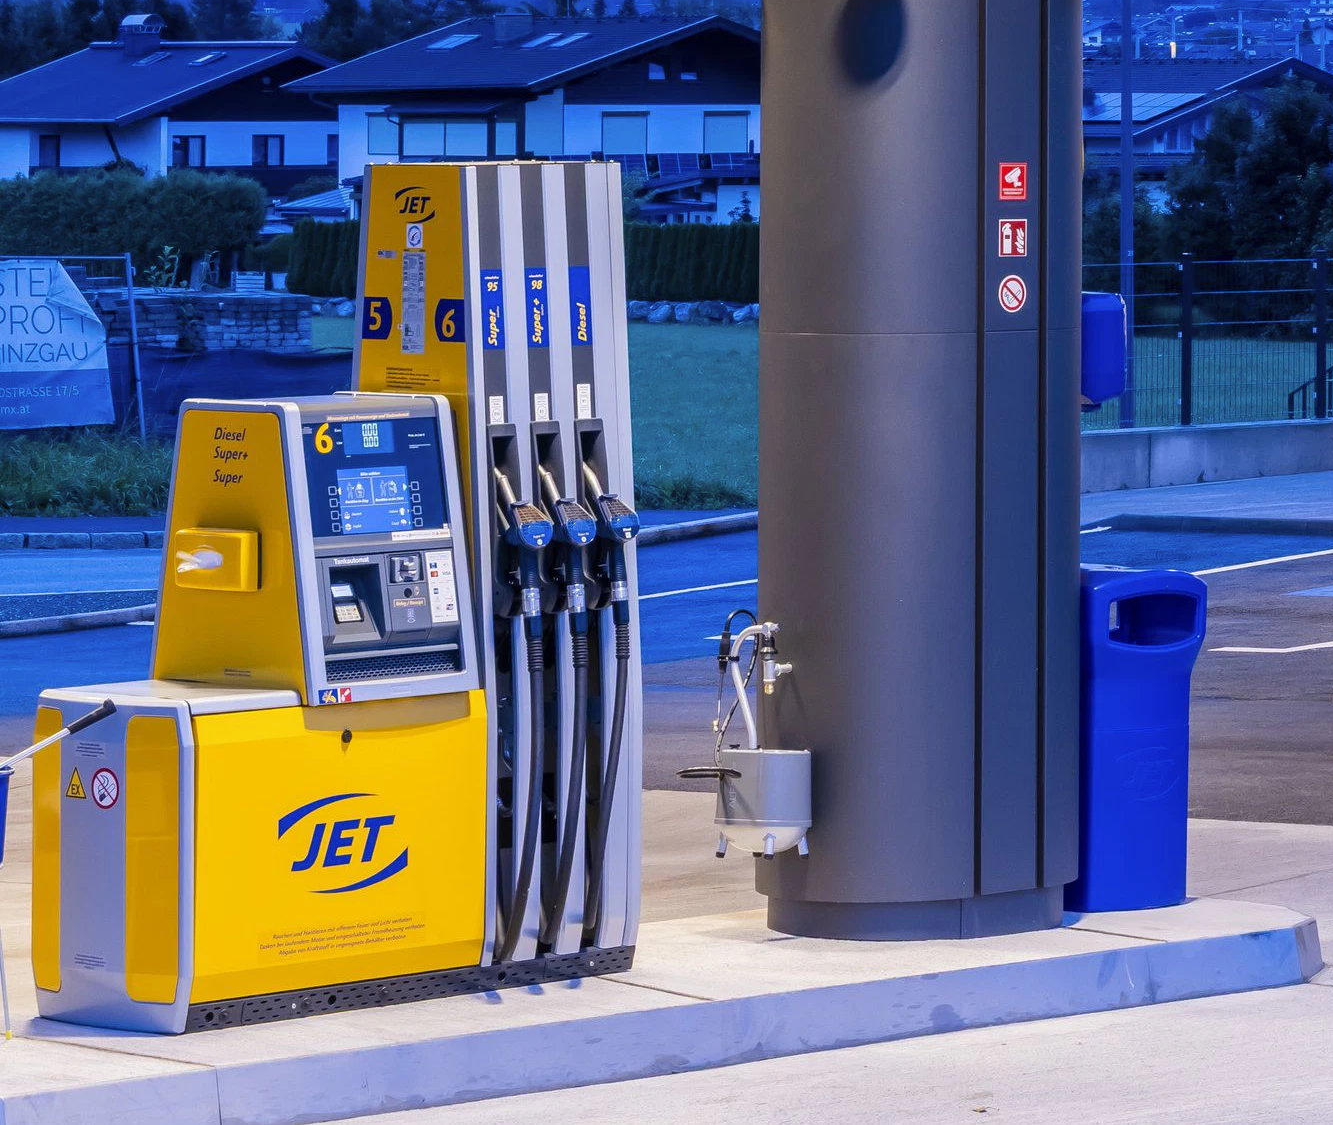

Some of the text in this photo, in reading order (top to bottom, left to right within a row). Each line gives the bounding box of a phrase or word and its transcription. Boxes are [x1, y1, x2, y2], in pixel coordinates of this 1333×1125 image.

[399, 196, 432, 214] JET
[487, 281, 499, 292] 95
[531, 280, 543, 290] 98
[369, 301, 382, 331] 5
[442, 308, 456, 338] 6
[576, 302, 588, 342] Diesel
[488, 308, 500, 346] Super
[0, 342, 88, 363] INZGAU
[56, 385, 80, 397] 17/5
[214, 426, 247, 442] Diesel
[315, 423, 334, 454] 6
[213, 446, 249, 464] Super+
[213, 469, 244, 487] Super
[334, 556, 370, 565] Tankautomat
[71, 784, 80, 796] EX
[291, 815, 396, 872] JET
